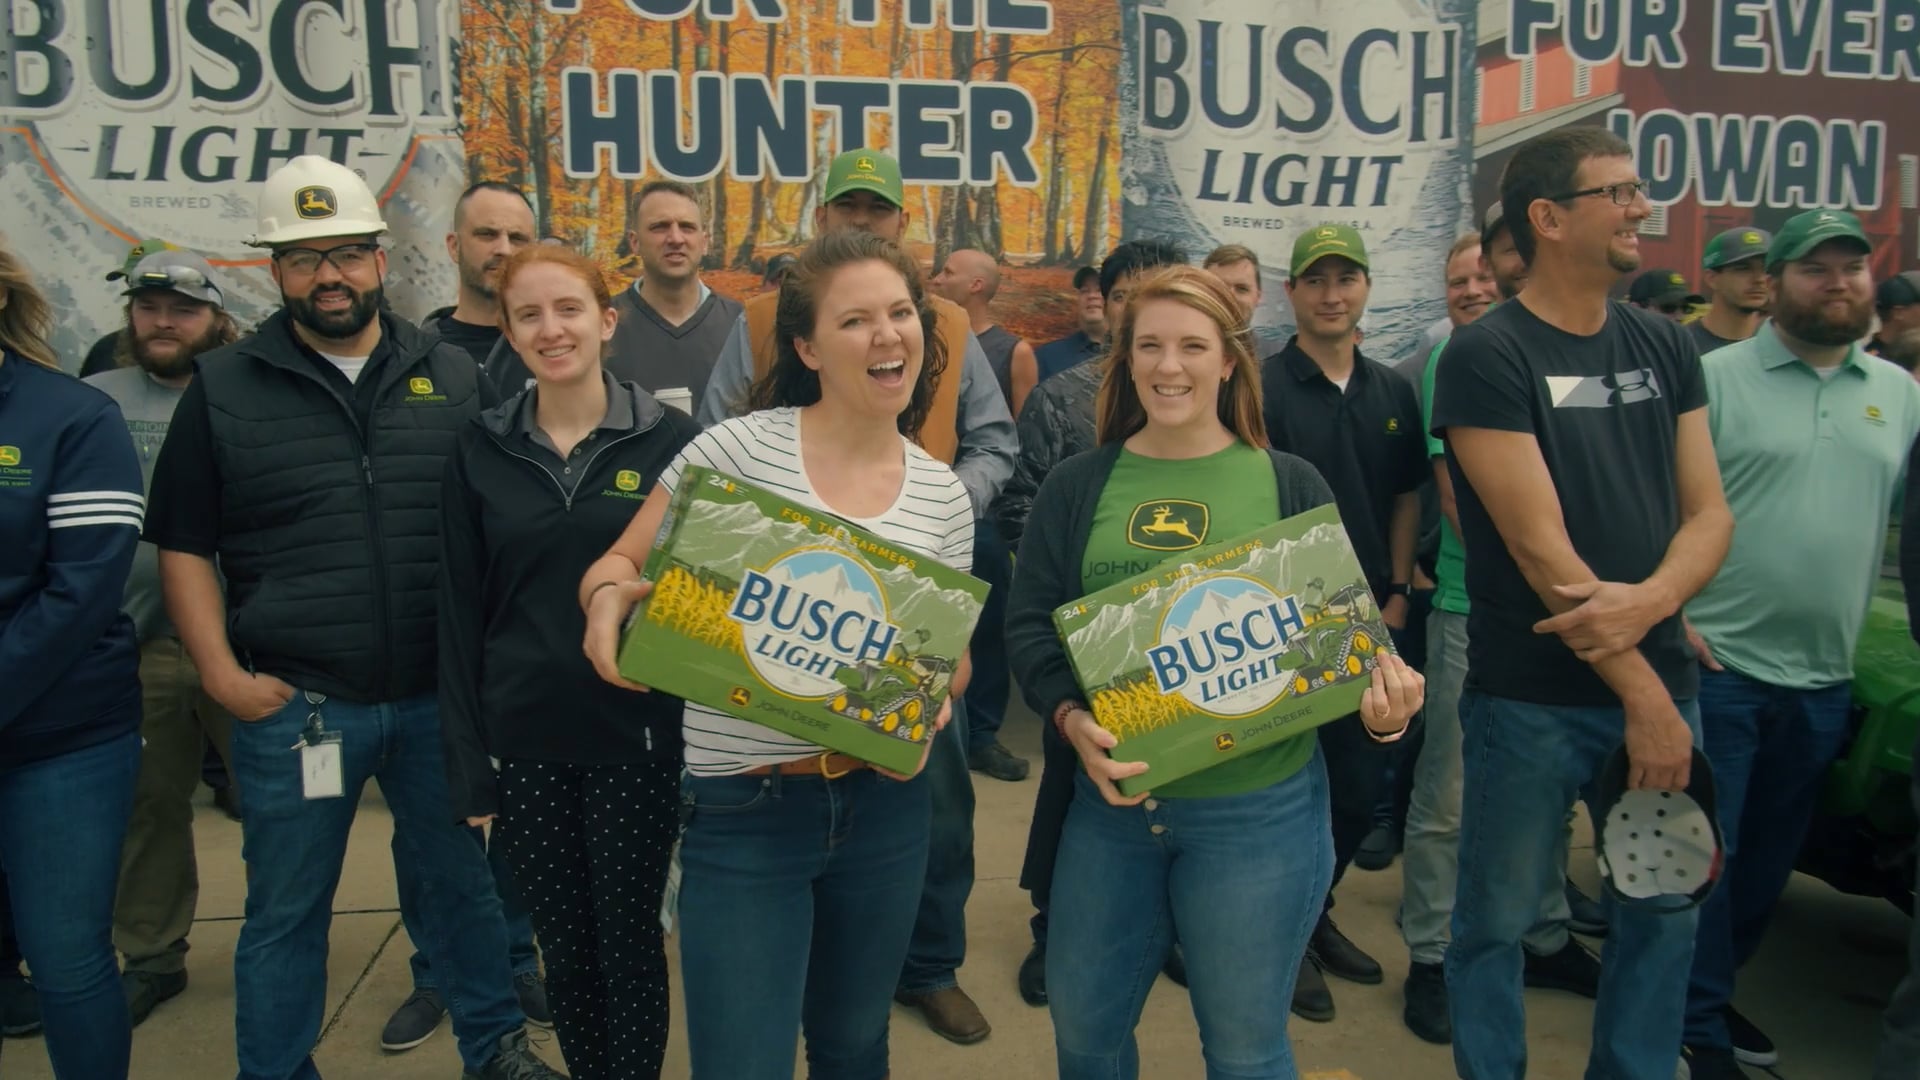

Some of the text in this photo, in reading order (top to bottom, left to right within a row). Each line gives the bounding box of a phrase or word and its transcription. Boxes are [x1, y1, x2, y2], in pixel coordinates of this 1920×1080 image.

[0, 0, 448, 116] BUSCH
[1506, 0, 1920, 82] FOR EVER
[1141, 12, 1457, 143] BUSCH
[92, 124, 364, 183] LIGHT
[563, 68, 1041, 188] HUNTER
[129, 196, 212, 209] BREWED
[1196, 149, 1404, 208] LIGHT
[1223, 215, 1284, 230] BREWED
[707, 475, 729, 490] 24
[782, 507, 917, 570] FOR THE FARMERS
[1084, 560, 1149, 580] JOHN
[1131, 539, 1264, 595] FOR THE FARMERS
[731, 570, 899, 664] BUSCH
[1062, 608, 1080, 620] 24
[755, 633, 849, 681] LIGHT
[1149, 595, 1305, 693] BUSCH
[1201, 652, 1284, 703] LIGHT
[755, 700, 831, 732] JOHN DEERE
[1241, 705, 1313, 741] JOHN DEERE
